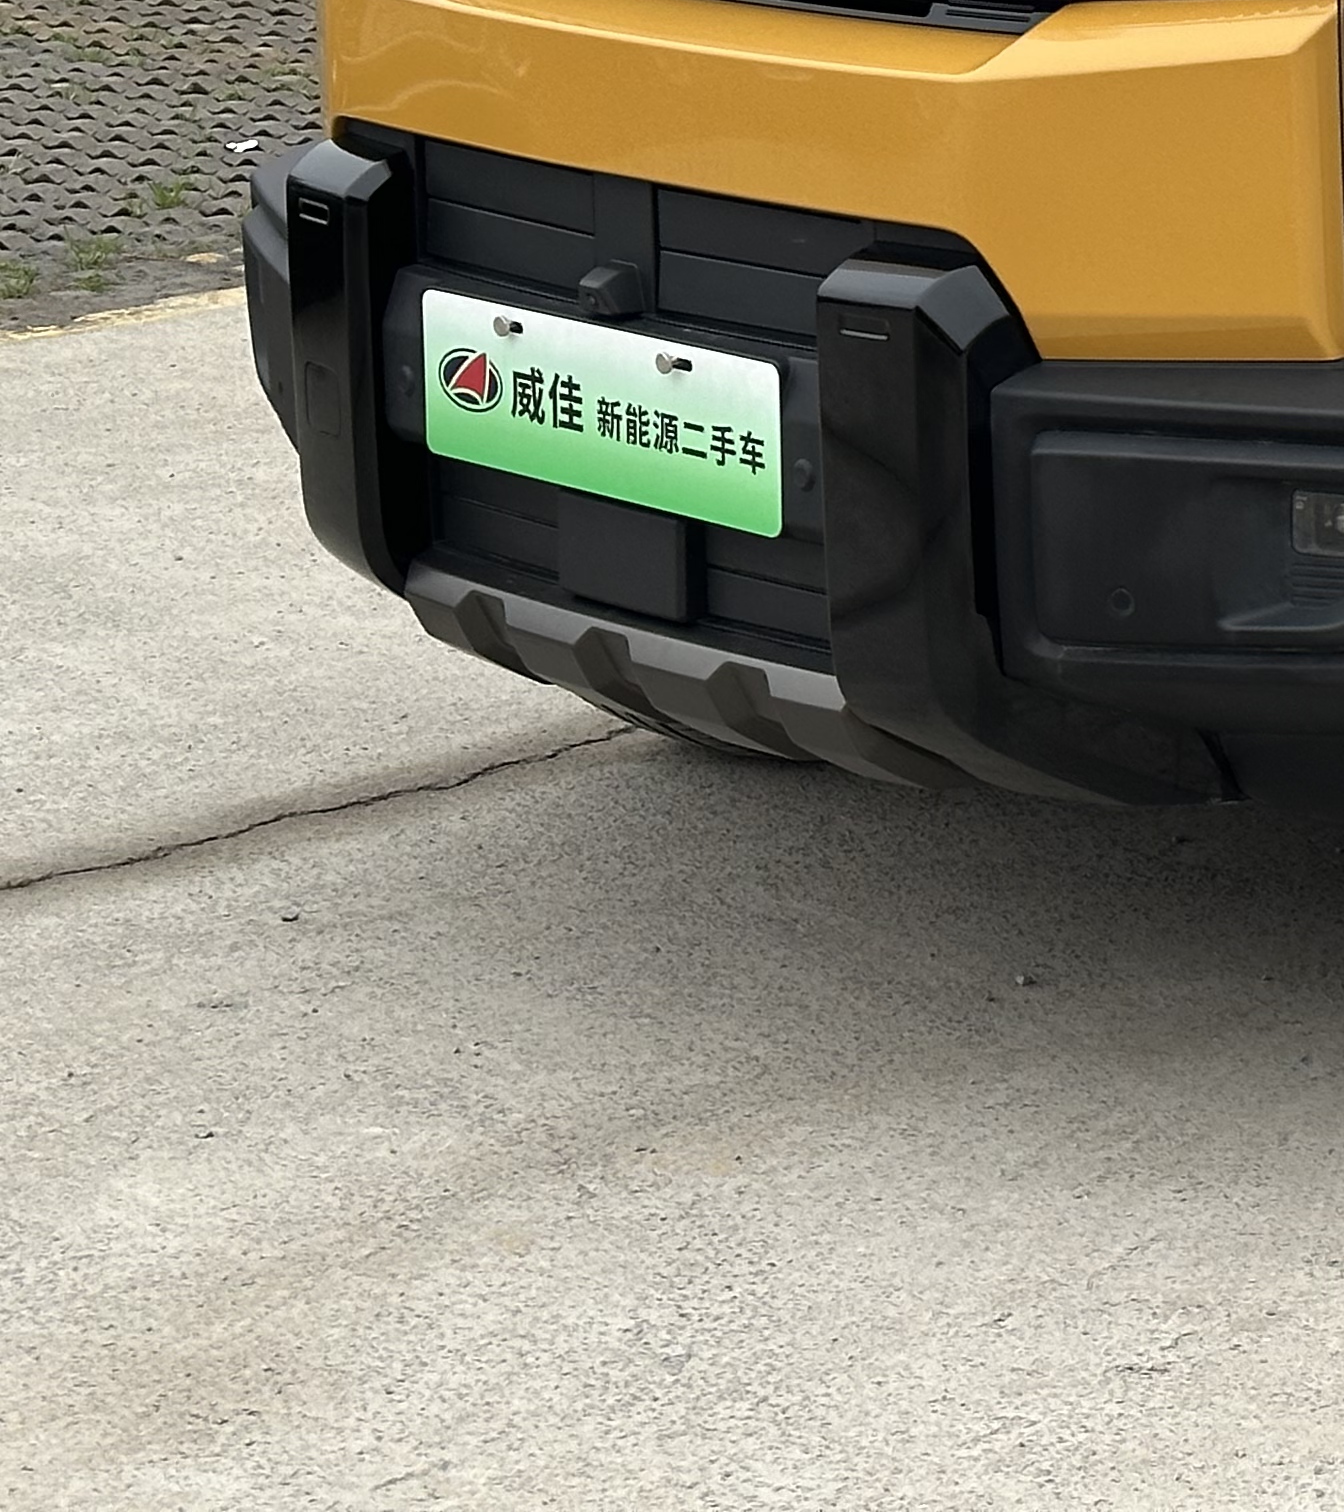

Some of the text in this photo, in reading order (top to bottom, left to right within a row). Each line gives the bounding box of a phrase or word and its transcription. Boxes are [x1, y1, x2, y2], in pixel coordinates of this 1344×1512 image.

[510, 366, 767, 476] 威佳 新能源二手车
